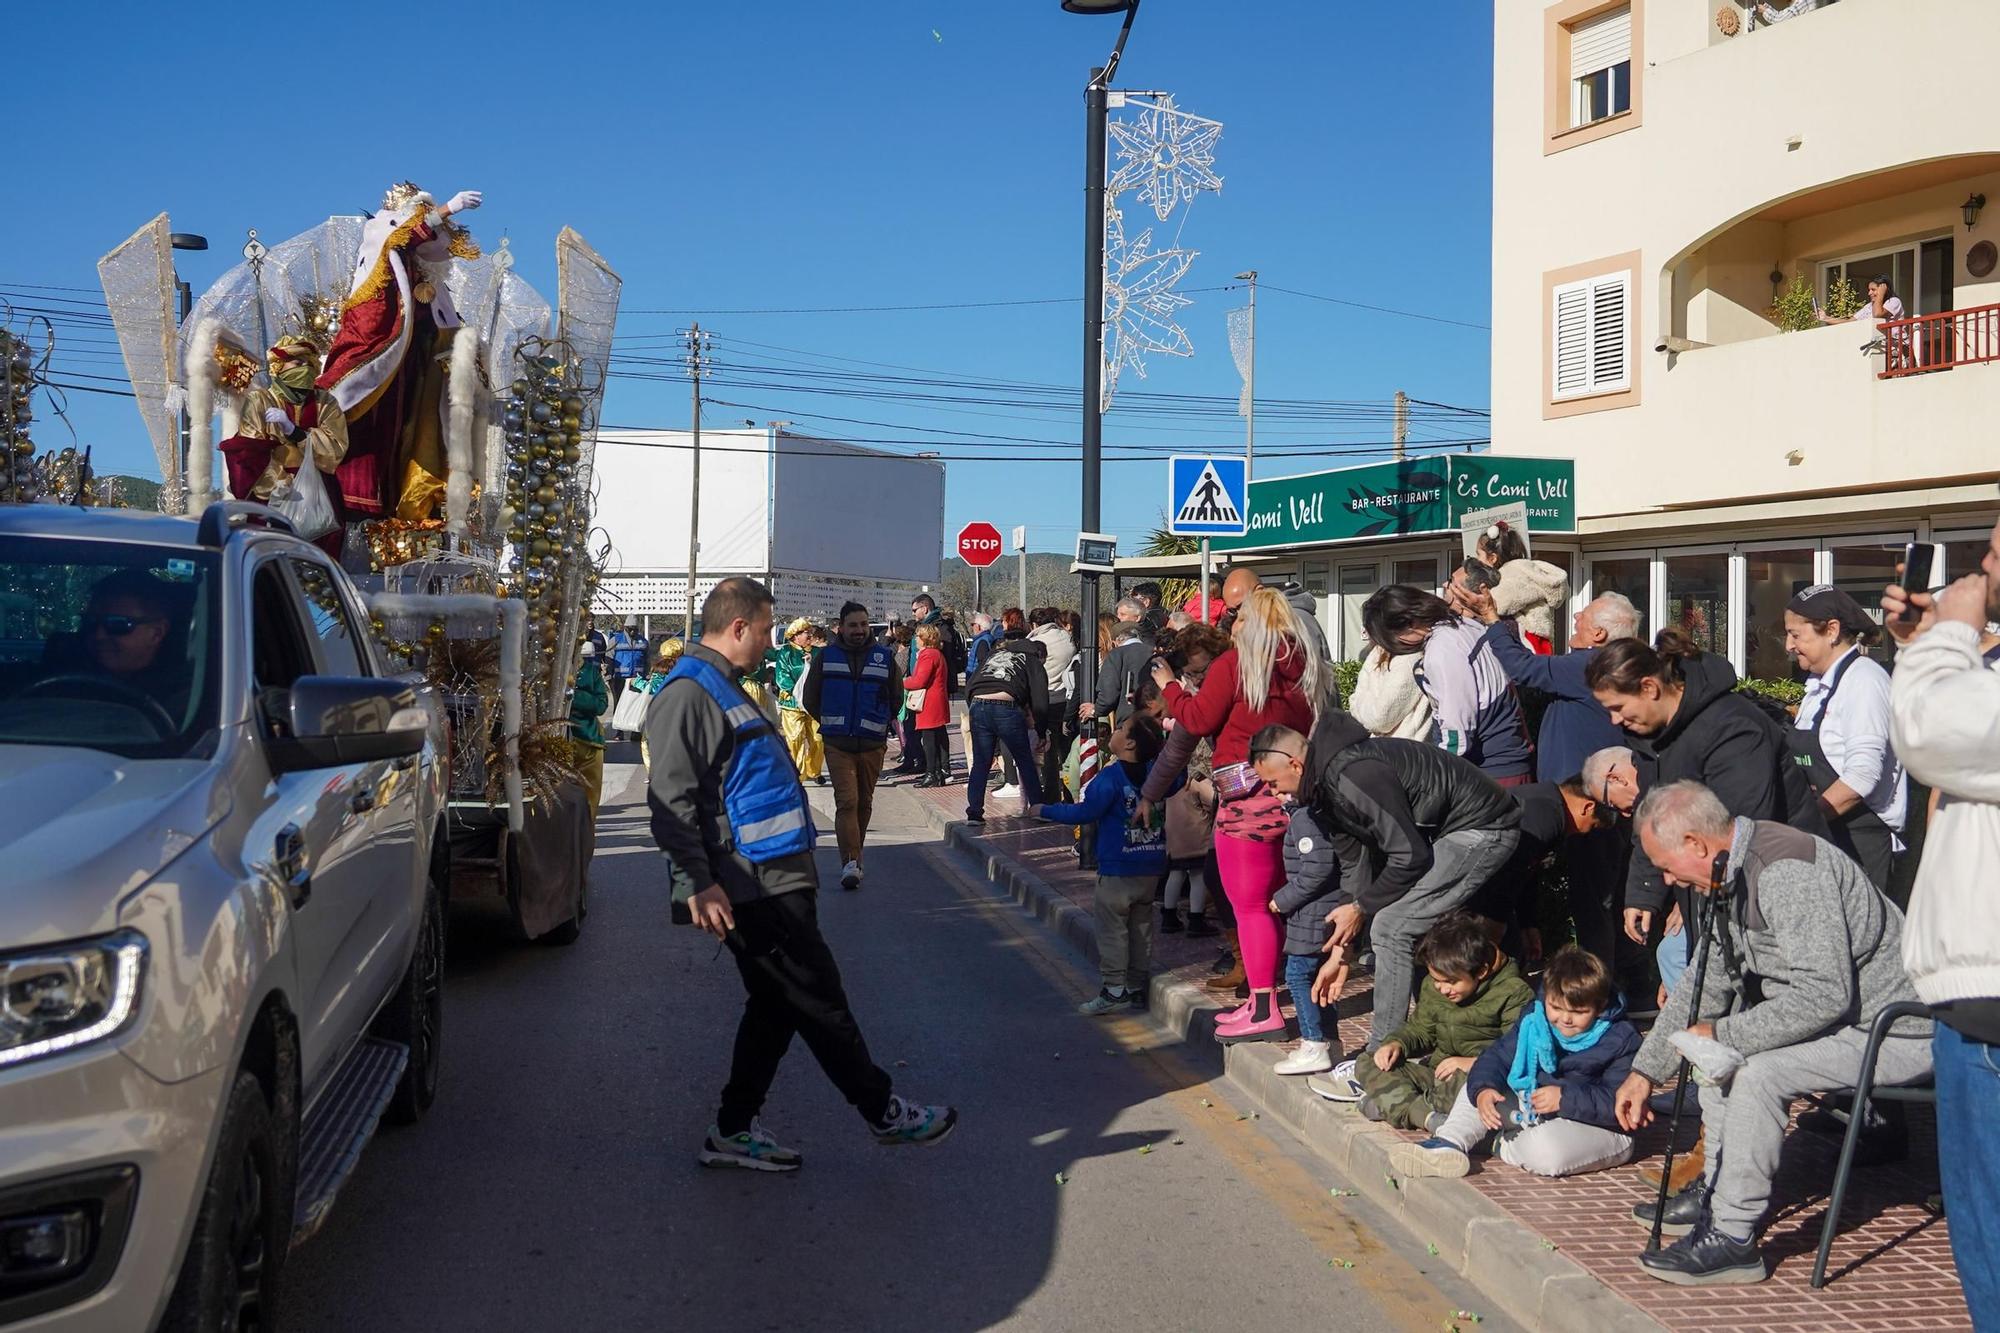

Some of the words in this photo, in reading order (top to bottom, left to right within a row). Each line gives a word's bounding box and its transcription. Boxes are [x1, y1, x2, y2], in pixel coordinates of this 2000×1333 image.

[1457, 473, 1479, 497] Es
[1487, 474, 1530, 497] Cami
[1537, 477, 1568, 500] Vell
[1289, 491, 1324, 531] Vell
[961, 539, 999, 550] STOP
